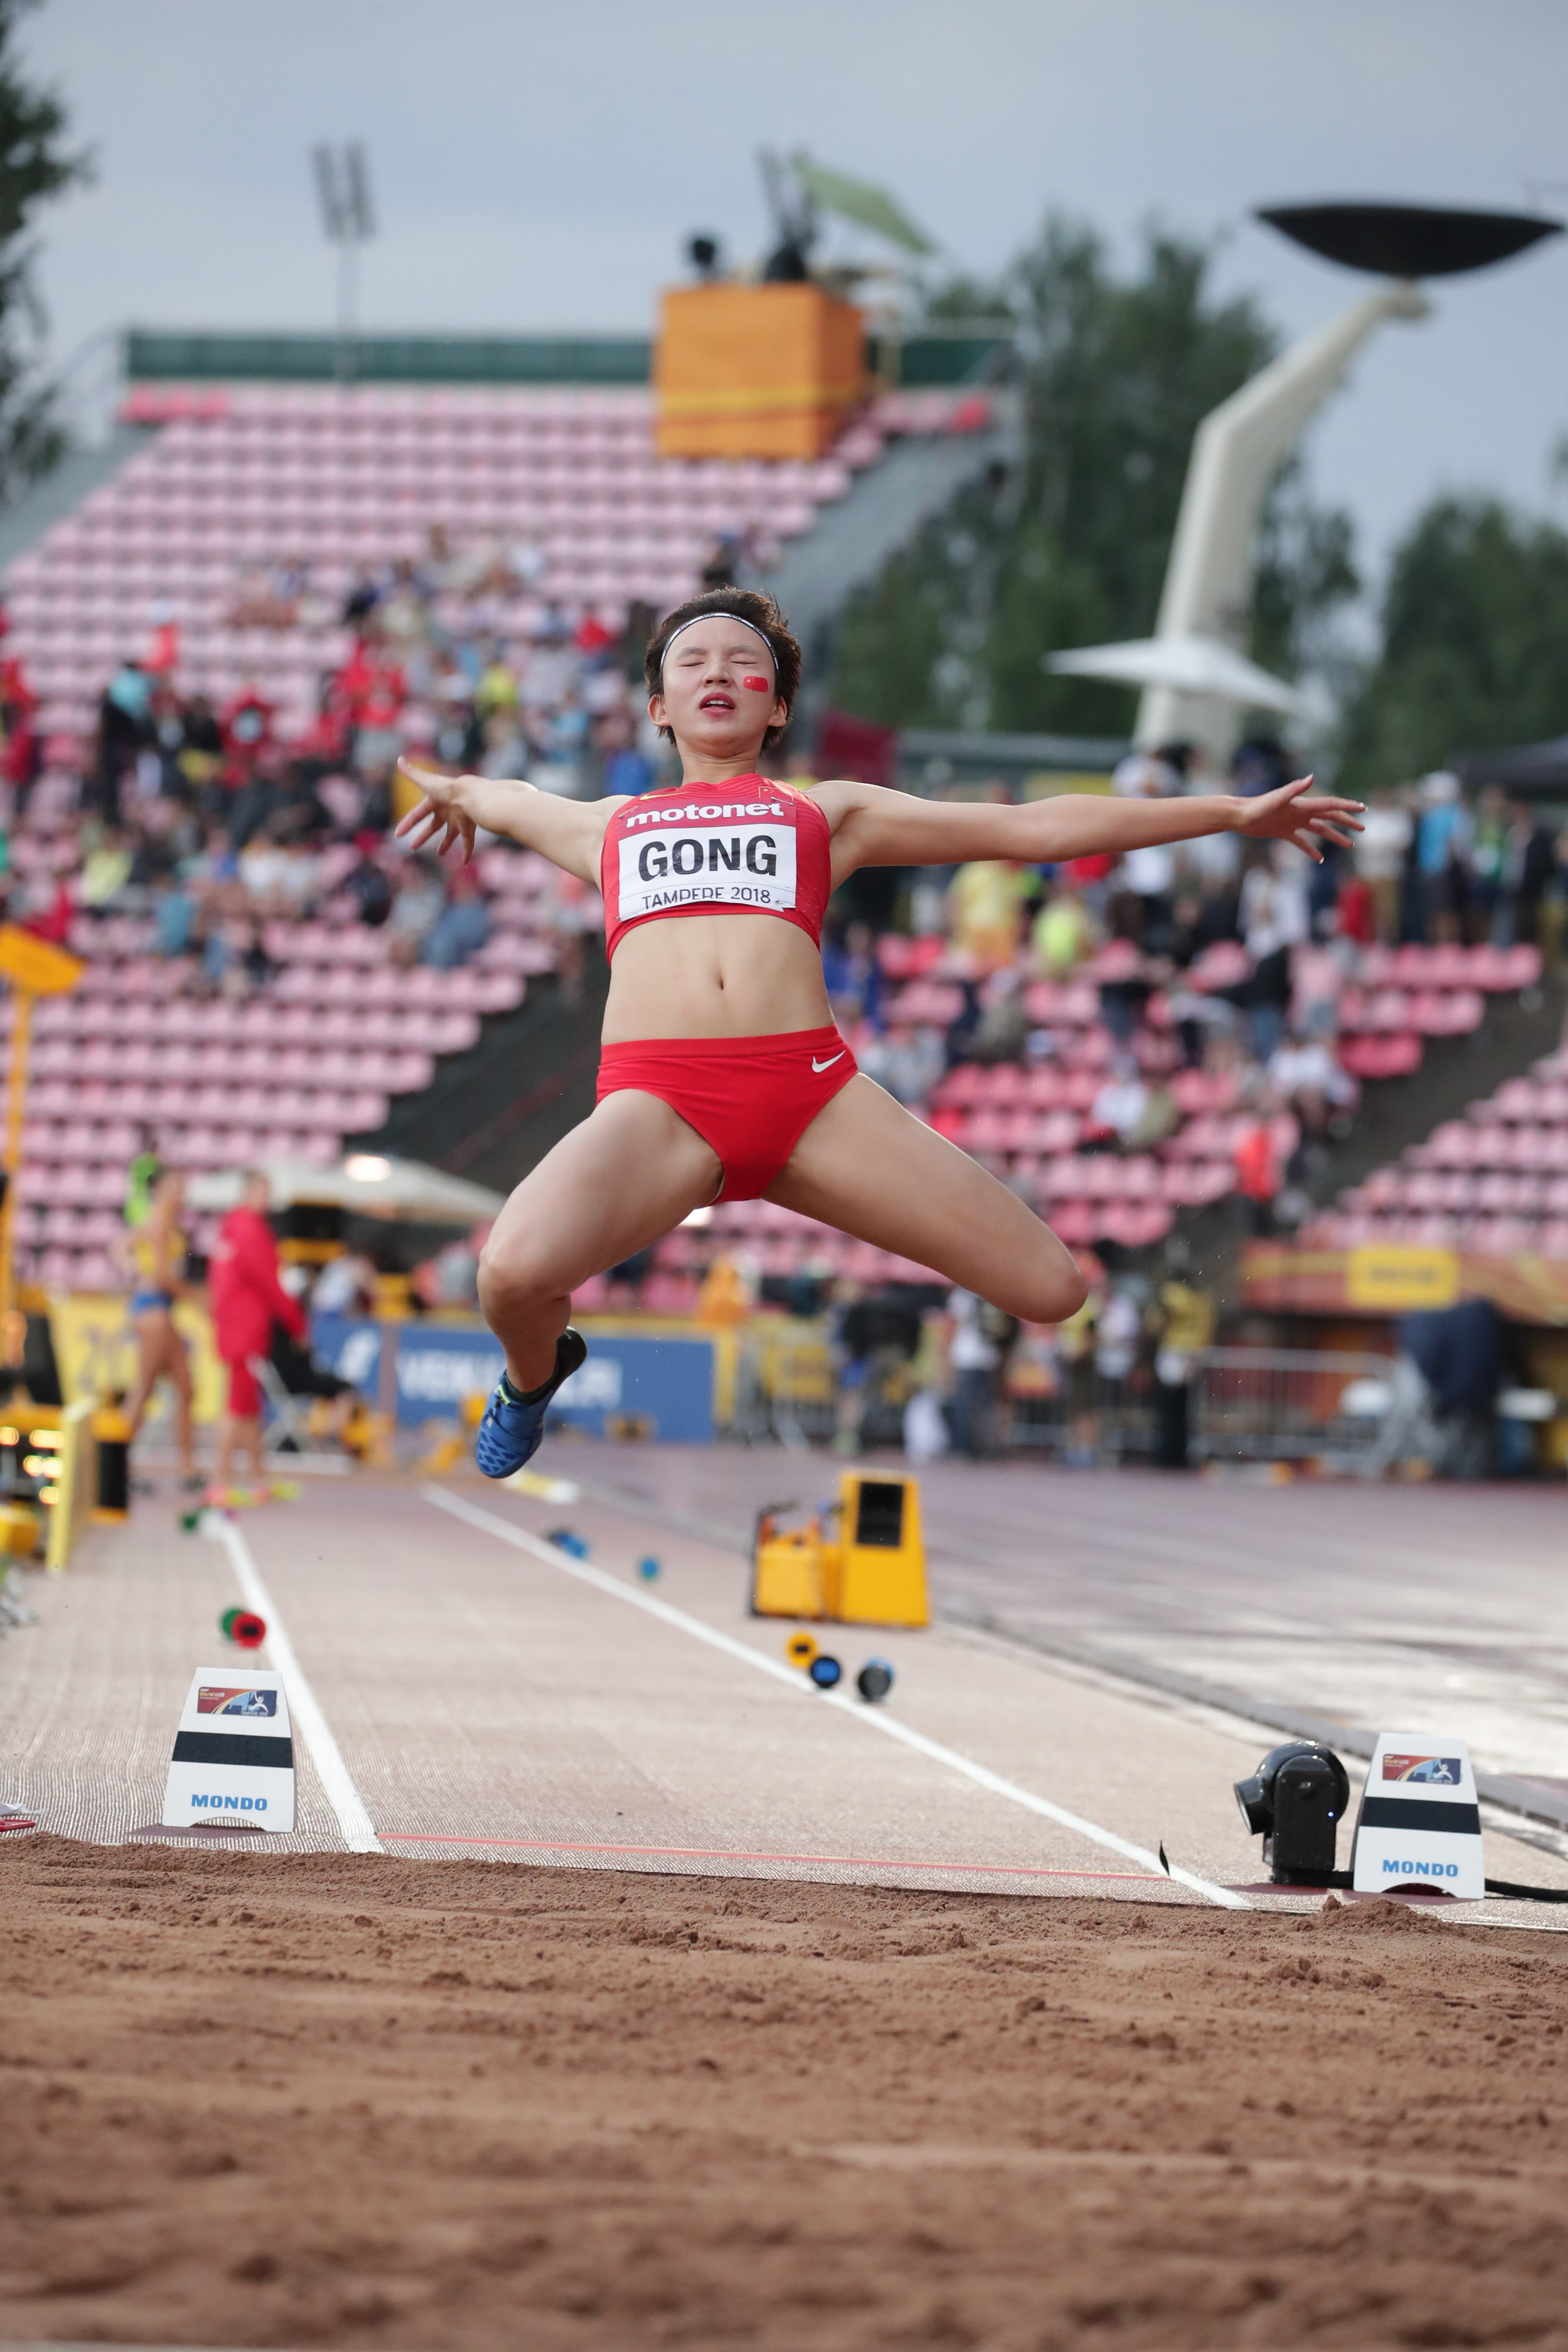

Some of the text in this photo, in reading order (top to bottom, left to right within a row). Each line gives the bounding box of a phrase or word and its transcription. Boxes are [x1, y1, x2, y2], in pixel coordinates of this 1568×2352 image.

[626, 803, 784, 828] motonet
[638, 835, 777, 882] GONG
[641, 887, 771, 909] TAMPERE 2018
[191, 1794, 268, 1811] MONDO
[1383, 1860, 1459, 1877] MONDO
